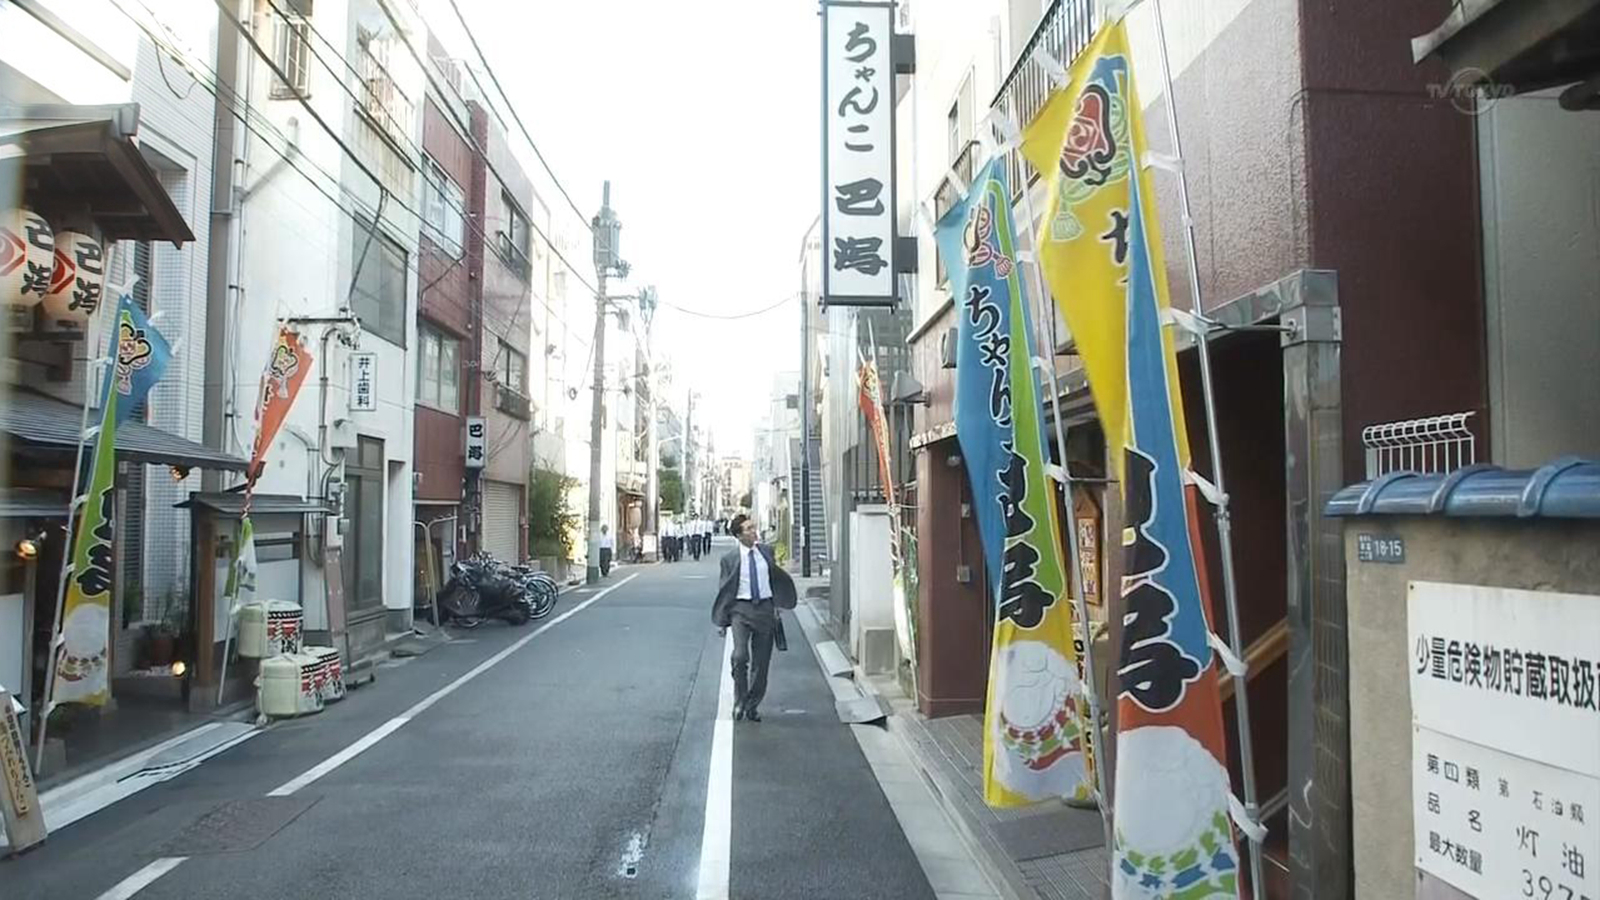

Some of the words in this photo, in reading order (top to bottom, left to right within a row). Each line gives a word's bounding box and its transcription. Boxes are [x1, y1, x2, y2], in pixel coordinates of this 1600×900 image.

[838, 21, 879, 153] ちゃんこ
[358, 356, 370, 408] 井上歯科
[1416, 633, 1600, 713] 少量危険物貯蔵取扱
[1429, 830, 1483, 875] 最大数量
[1516, 825, 1585, 880] 灯油
